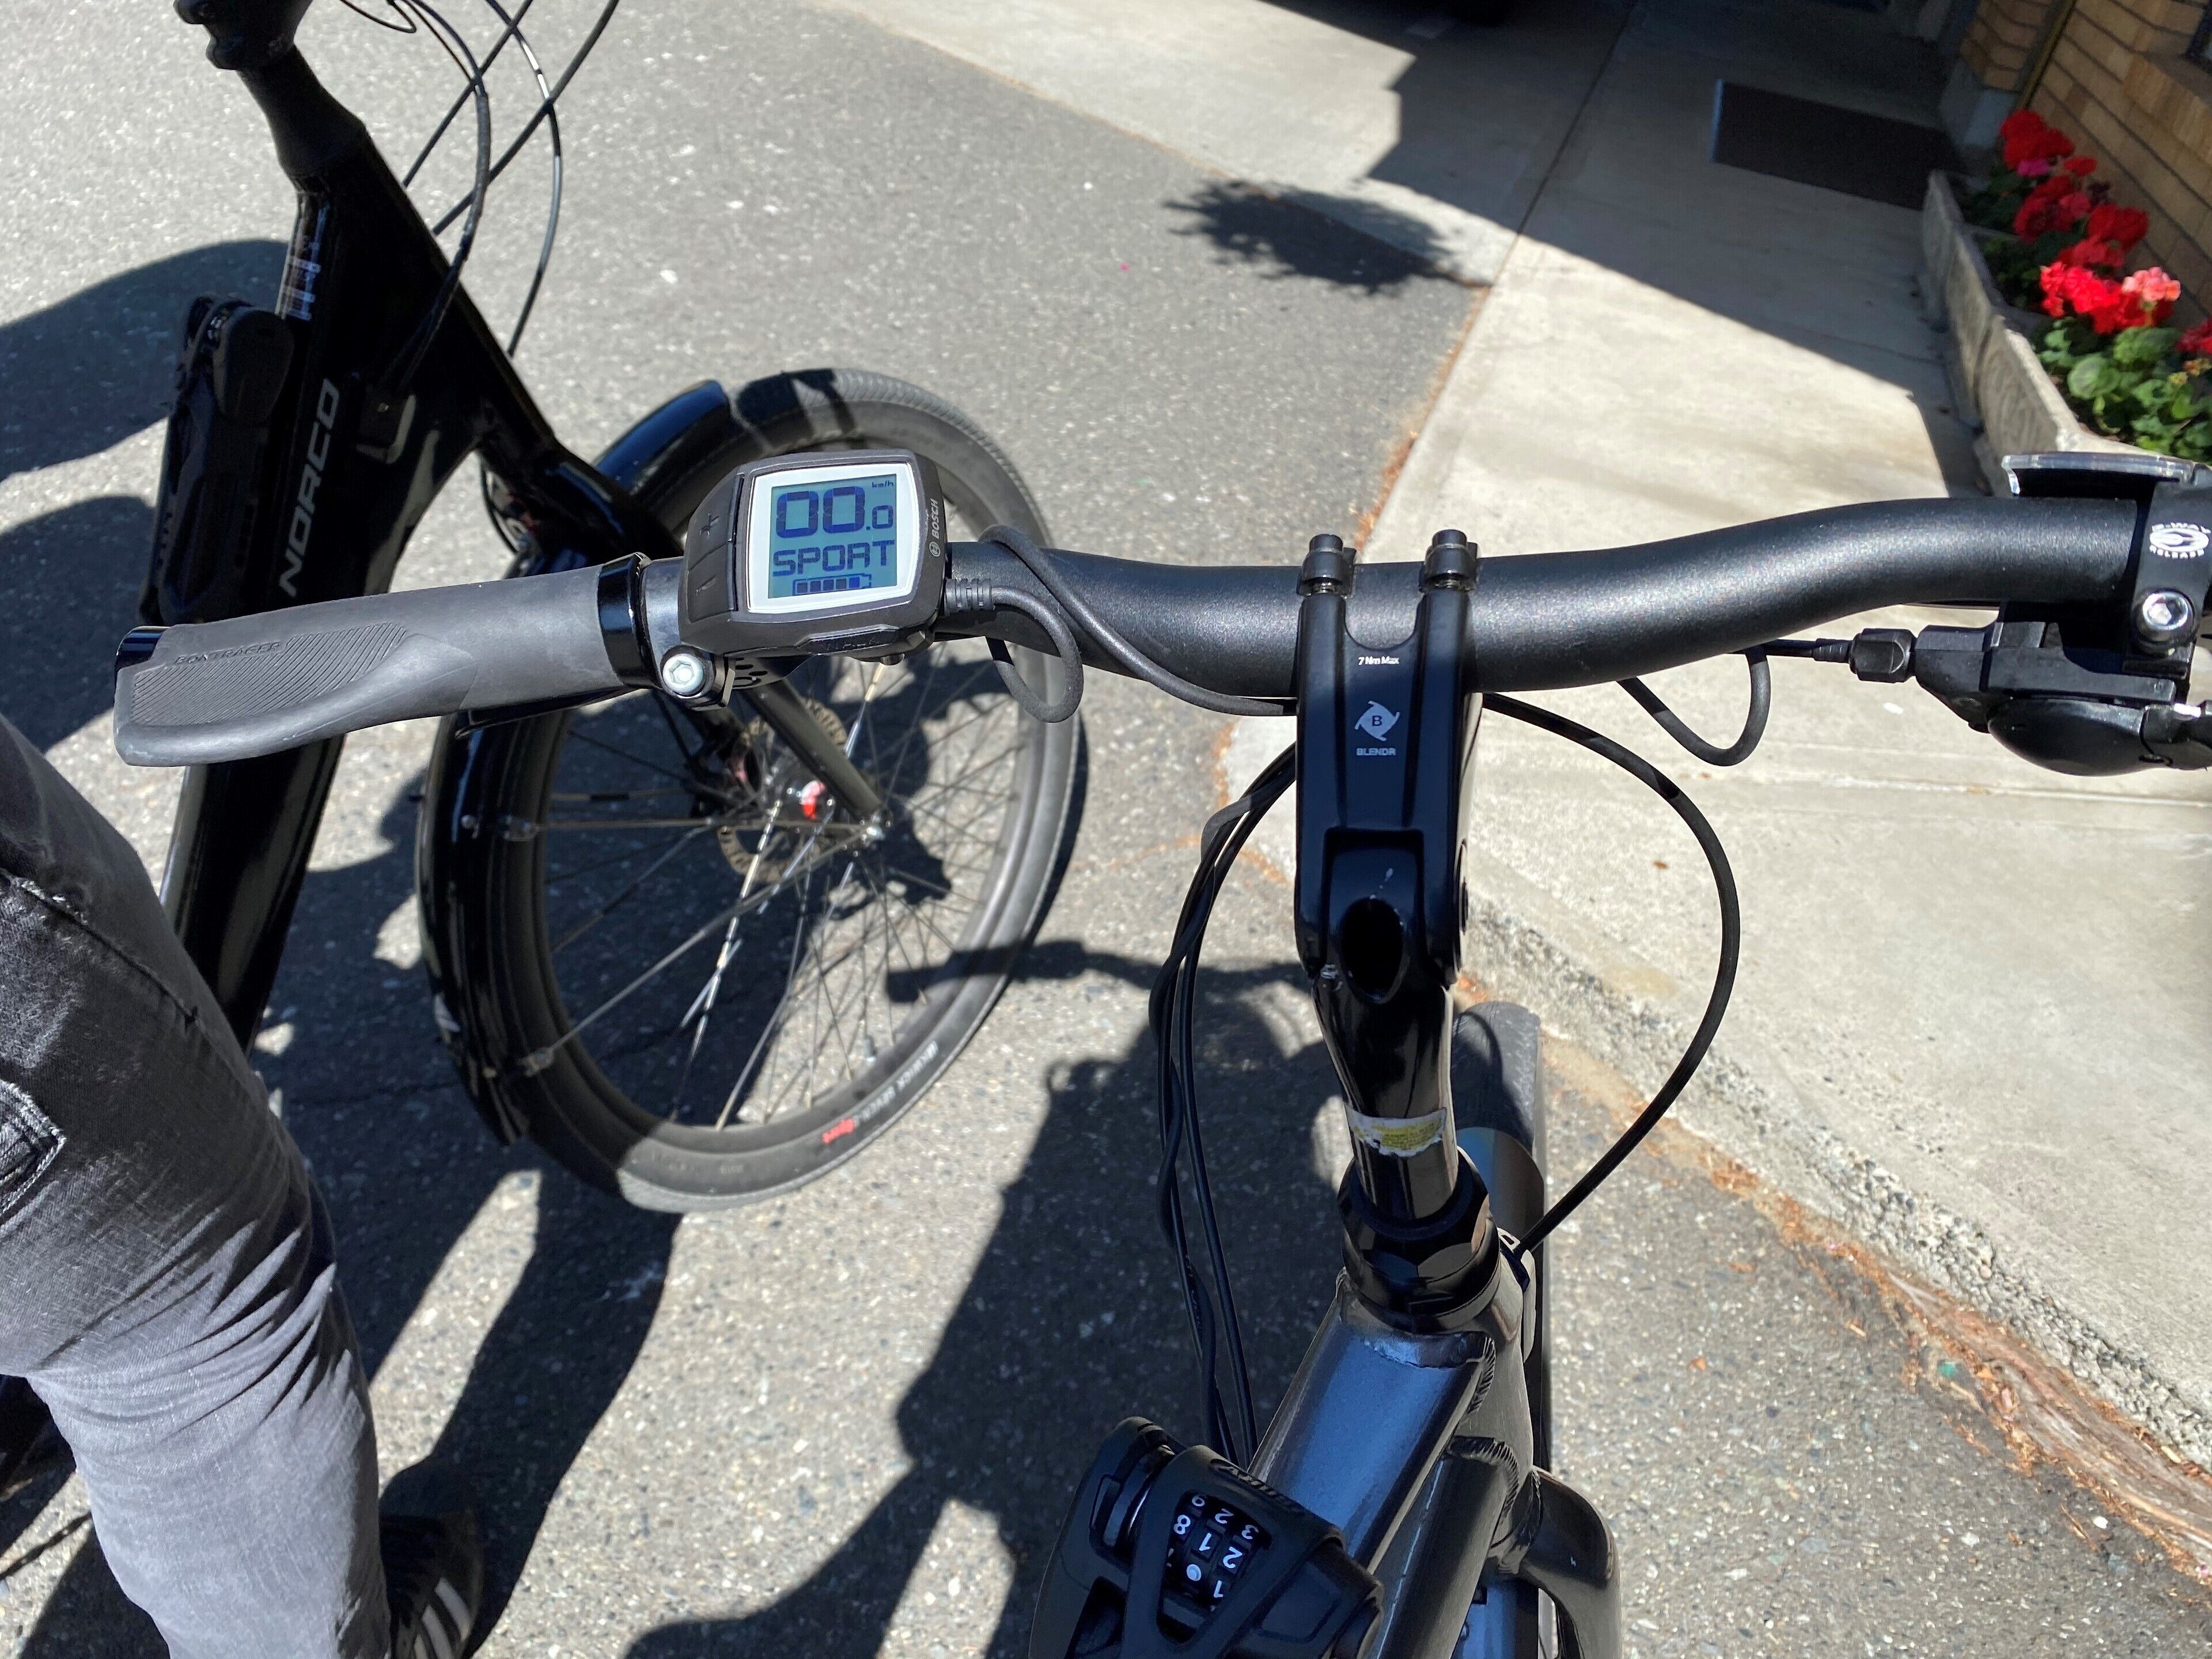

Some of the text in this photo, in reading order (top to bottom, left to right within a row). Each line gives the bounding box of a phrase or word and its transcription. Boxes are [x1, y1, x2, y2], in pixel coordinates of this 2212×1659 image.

[279, 378, 340, 597] NORCO
[872, 480, 893, 488] km/h
[776, 486, 893, 538] 00.0
[930, 497, 940, 540] BOSCH
[772, 540, 895, 576] SPORT
[1358, 656, 1400, 665] 7 Nm Max
[1372, 715, 1382, 726] B
[1356, 748, 1396, 756] BLENDR
[1173, 1514, 1191, 1535] 8
[1222, 1546, 1243, 1569] 2
